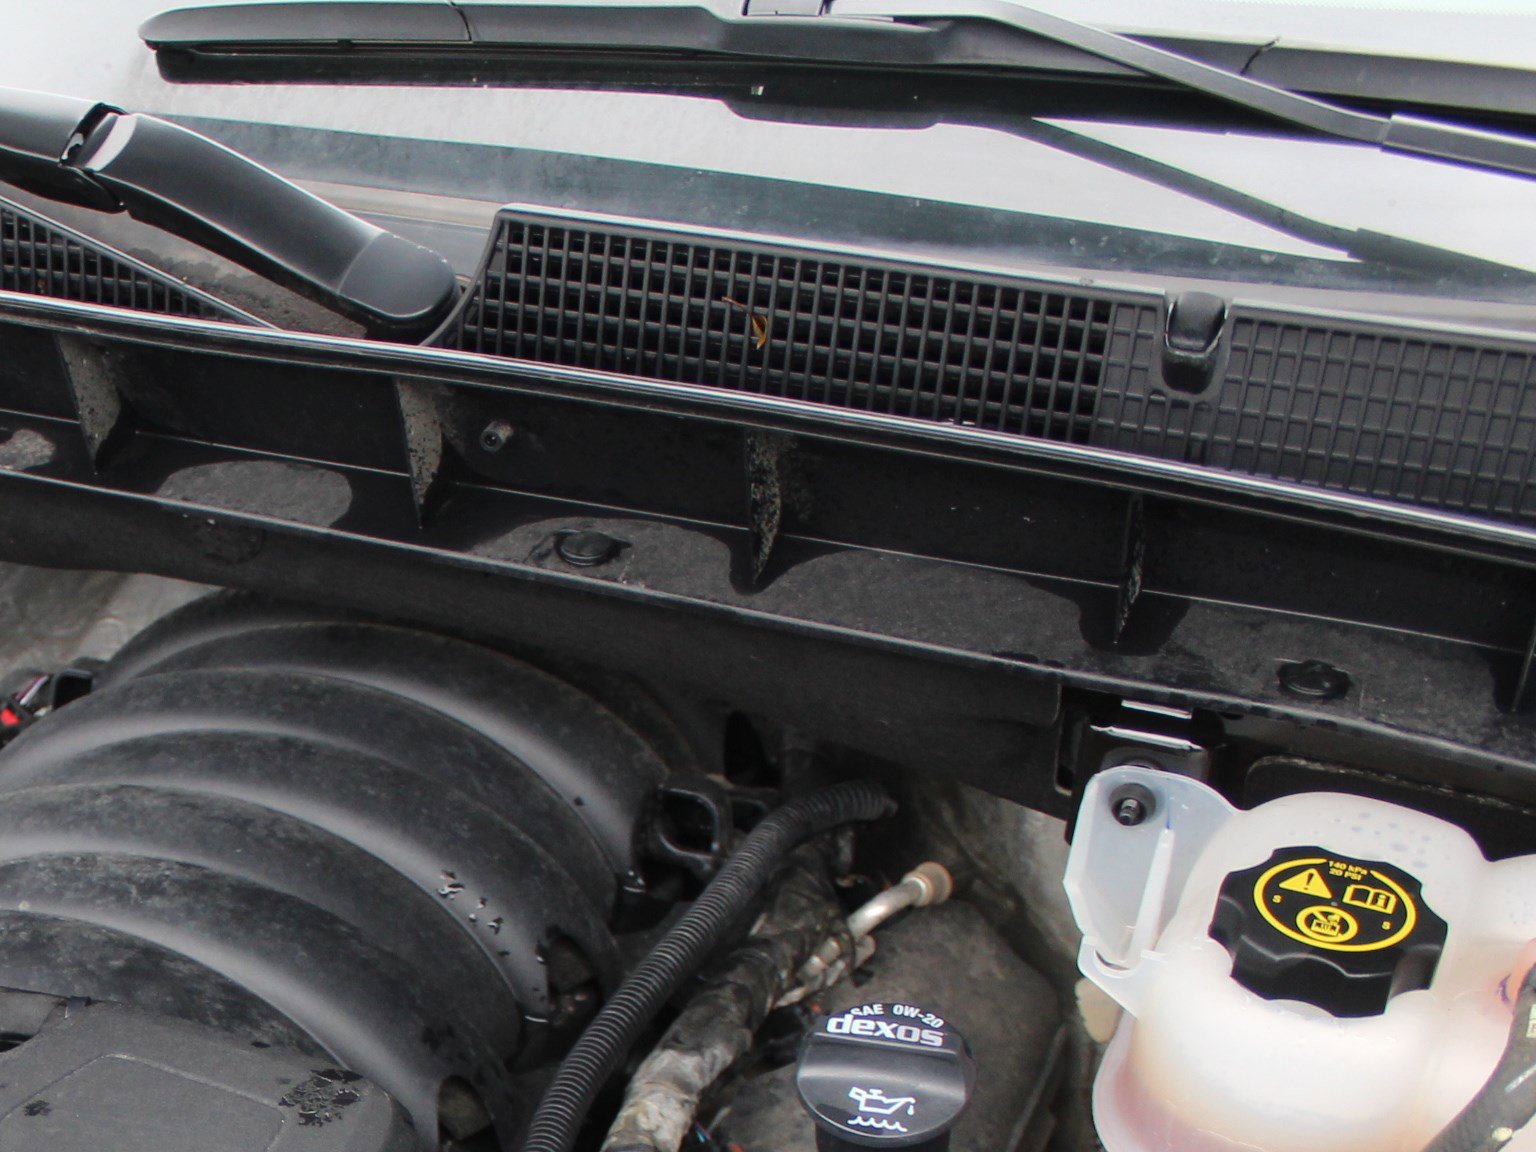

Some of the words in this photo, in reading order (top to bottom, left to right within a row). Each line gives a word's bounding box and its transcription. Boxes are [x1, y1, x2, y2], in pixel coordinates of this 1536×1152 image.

[1329, 868, 1342, 877] 20
[1344, 871, 1362, 881] PSI
[1348, 864, 1368, 876] kPa
[850, 1003, 884, 1016] SAE
[892, 1004, 944, 1028] 0W-20
[826, 1013, 944, 1047] dexos
